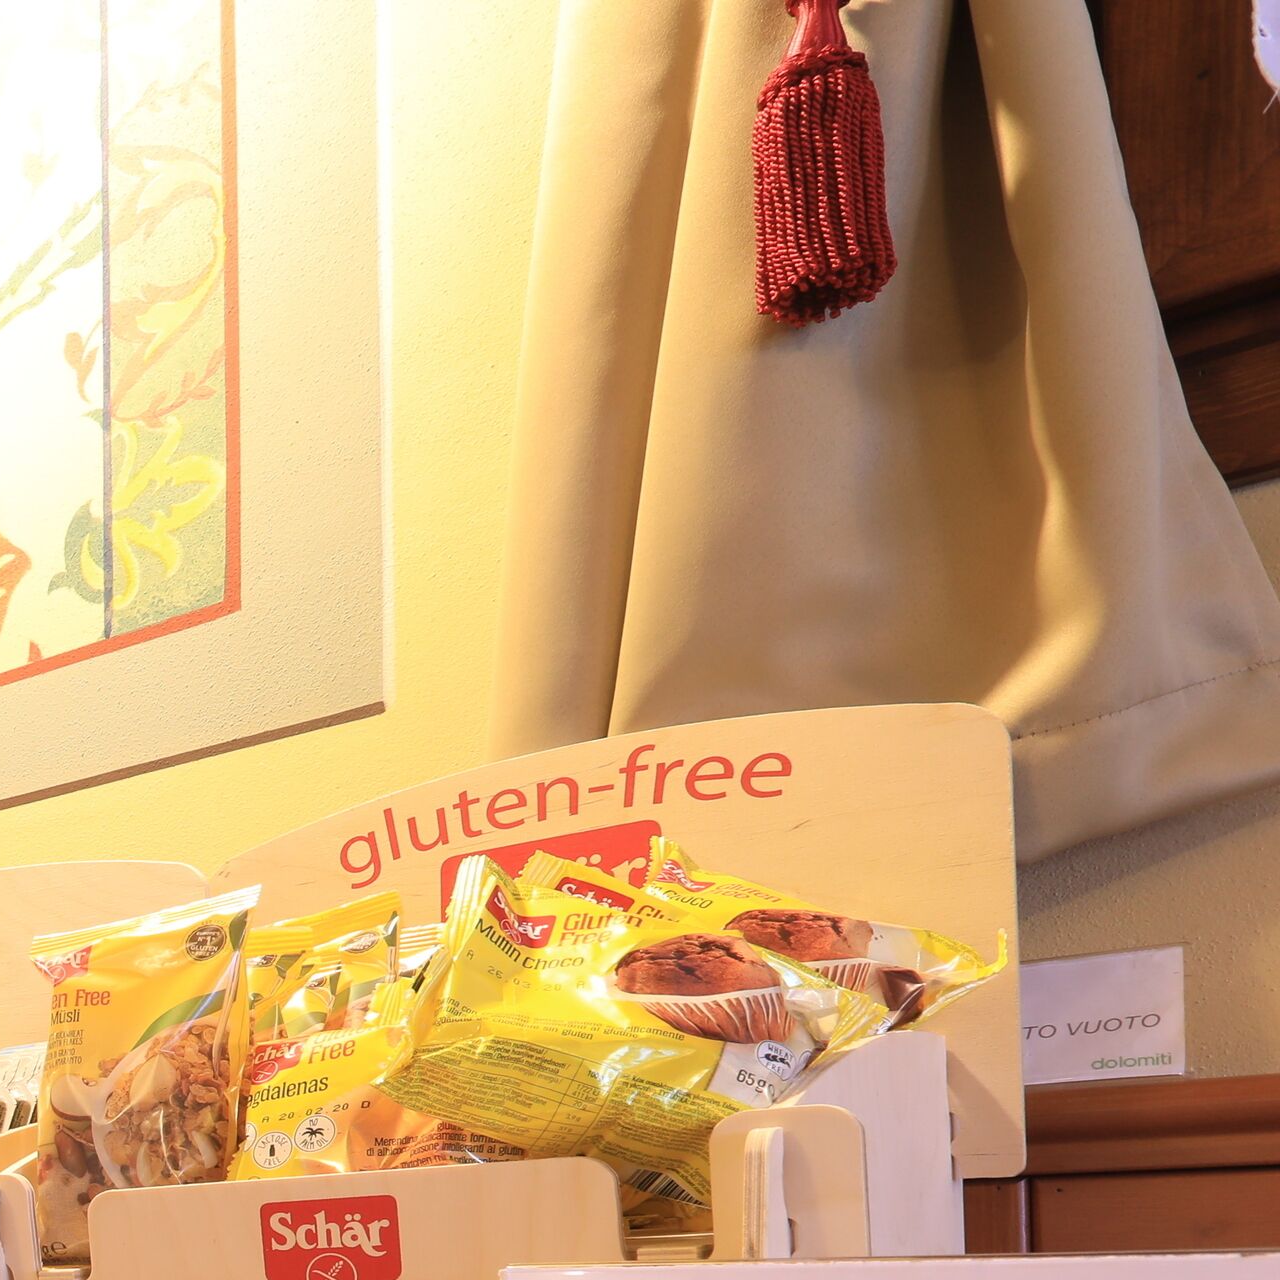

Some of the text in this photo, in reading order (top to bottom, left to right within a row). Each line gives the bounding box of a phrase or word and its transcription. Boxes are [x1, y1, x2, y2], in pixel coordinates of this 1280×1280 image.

[339, 743, 793, 890] gluten-free
[564, 913, 644, 932] Gluten
[558, 930, 613, 947] Free
[522, 956, 584, 971] Choco
[75, 989, 111, 1007] Free
[51, 1008, 81, 1027] Müsli
[1066, 1013, 1161, 1037] VUOTO
[253, 1043, 302, 1064] chär
[308, 1039, 356, 1065] Free
[1091, 1051, 1172, 1070] dolomiti
[269, 1210, 390, 1258] Schär
